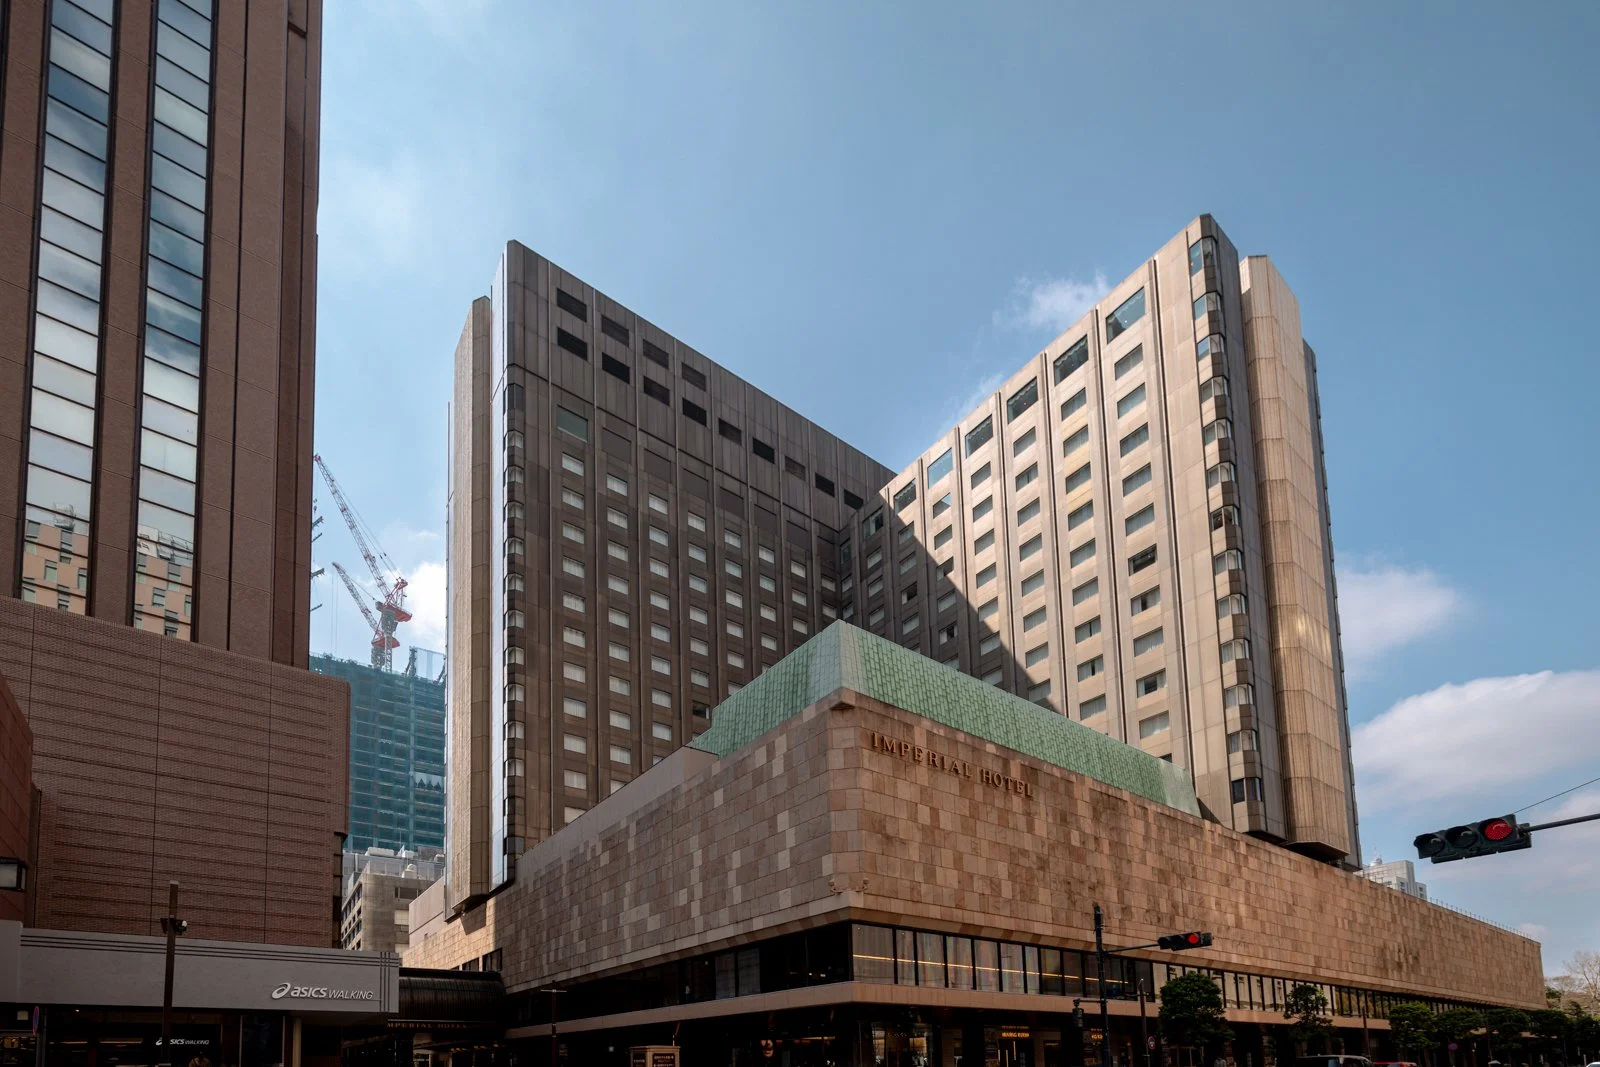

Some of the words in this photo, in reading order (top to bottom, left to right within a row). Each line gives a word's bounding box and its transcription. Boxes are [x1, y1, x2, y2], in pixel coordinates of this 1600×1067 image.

[871, 732, 973, 777] IMPERIAL
[981, 769, 1034, 798] HOTEL
[328, 990, 374, 1000] WALKING
